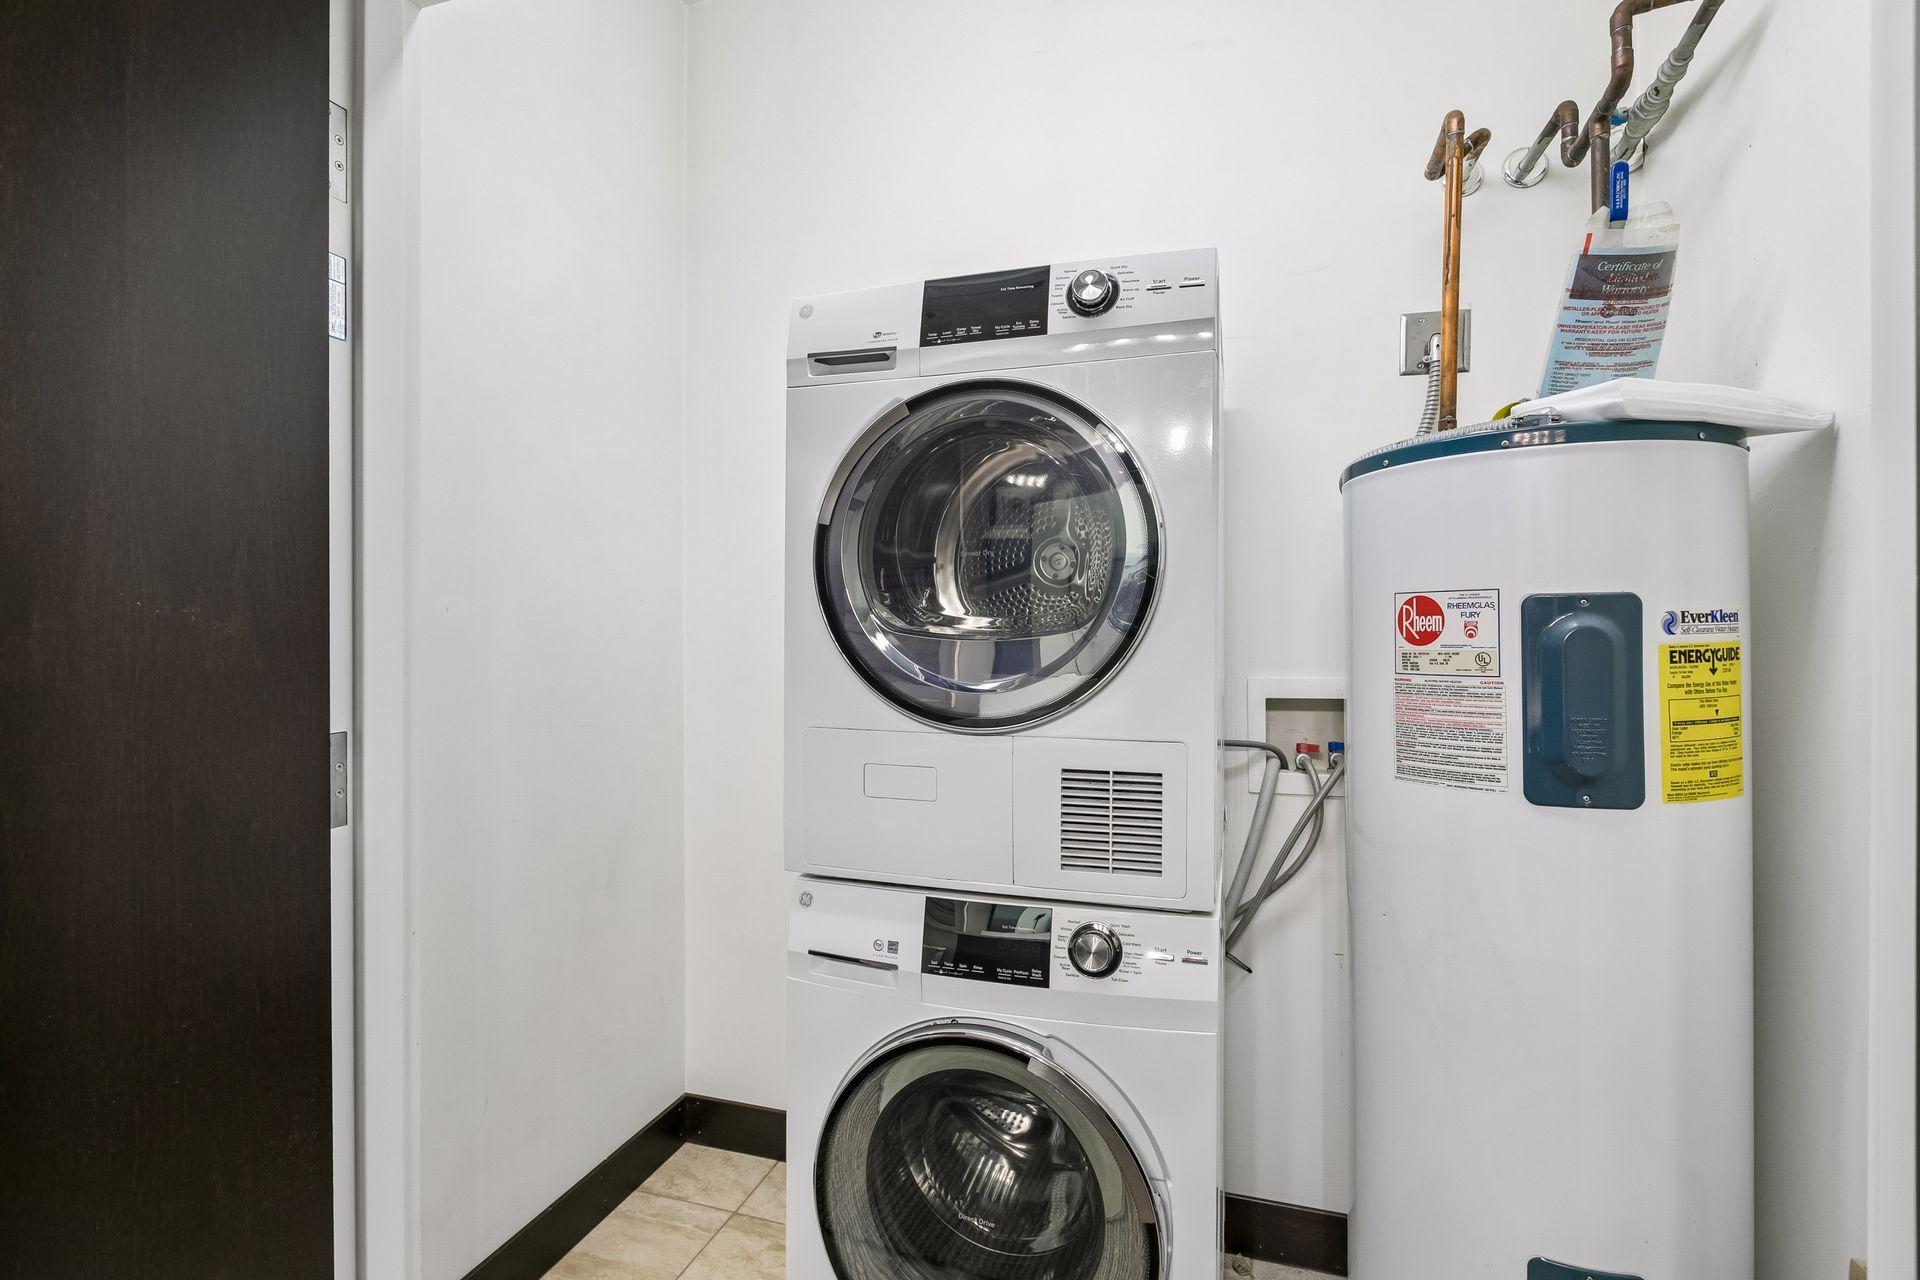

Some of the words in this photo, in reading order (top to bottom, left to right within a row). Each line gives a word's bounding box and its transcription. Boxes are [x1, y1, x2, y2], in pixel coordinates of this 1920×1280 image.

[1598, 261, 1650, 271] Certificate
[1652, 259, 1663, 270] of
[1602, 285, 1649, 294] Warranty
[1447, 602, 1495, 610] RHEEMGLAS
[1402, 598, 1442, 639] Rheem
[1681, 609, 1738, 623] EverKleen
[1669, 647, 1740, 664] ENERGYGUIDE
[958, 1212, 978, 1224] Direct
[978, 1217, 996, 1228] Drive
